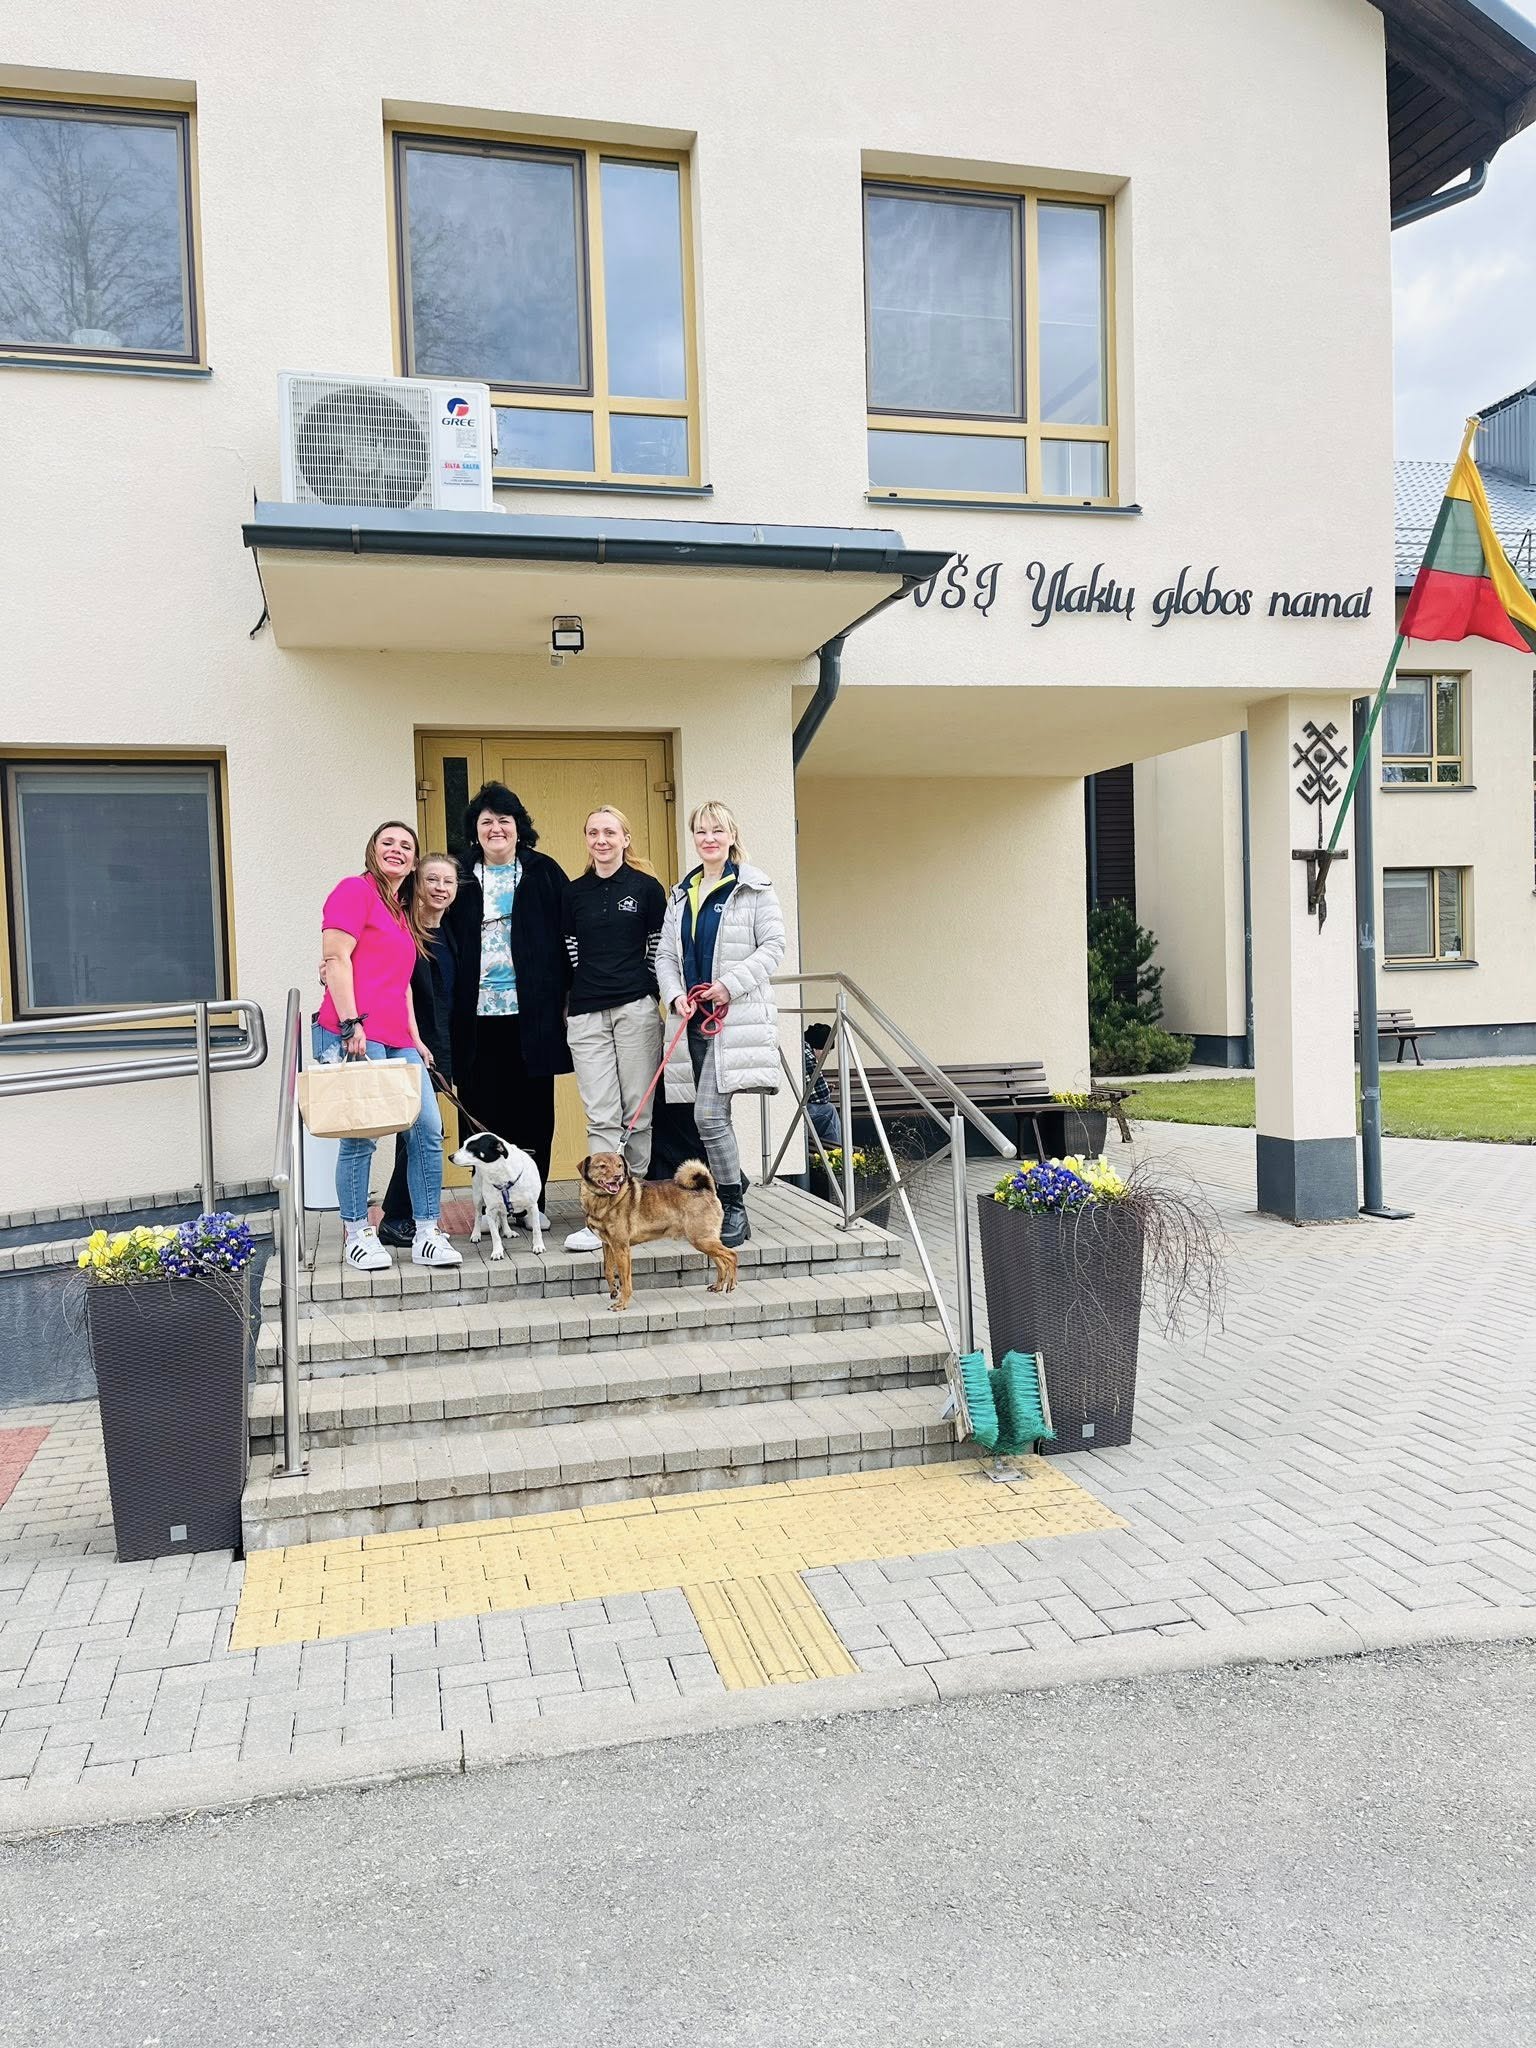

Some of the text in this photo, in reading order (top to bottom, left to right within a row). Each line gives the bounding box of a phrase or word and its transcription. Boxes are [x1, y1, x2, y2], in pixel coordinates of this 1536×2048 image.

[441, 417, 476, 427] GREE
[1025, 561, 1136, 628] Ylakių
[1152, 565, 1253, 628] globos
[1268, 586, 1373, 618] namai
